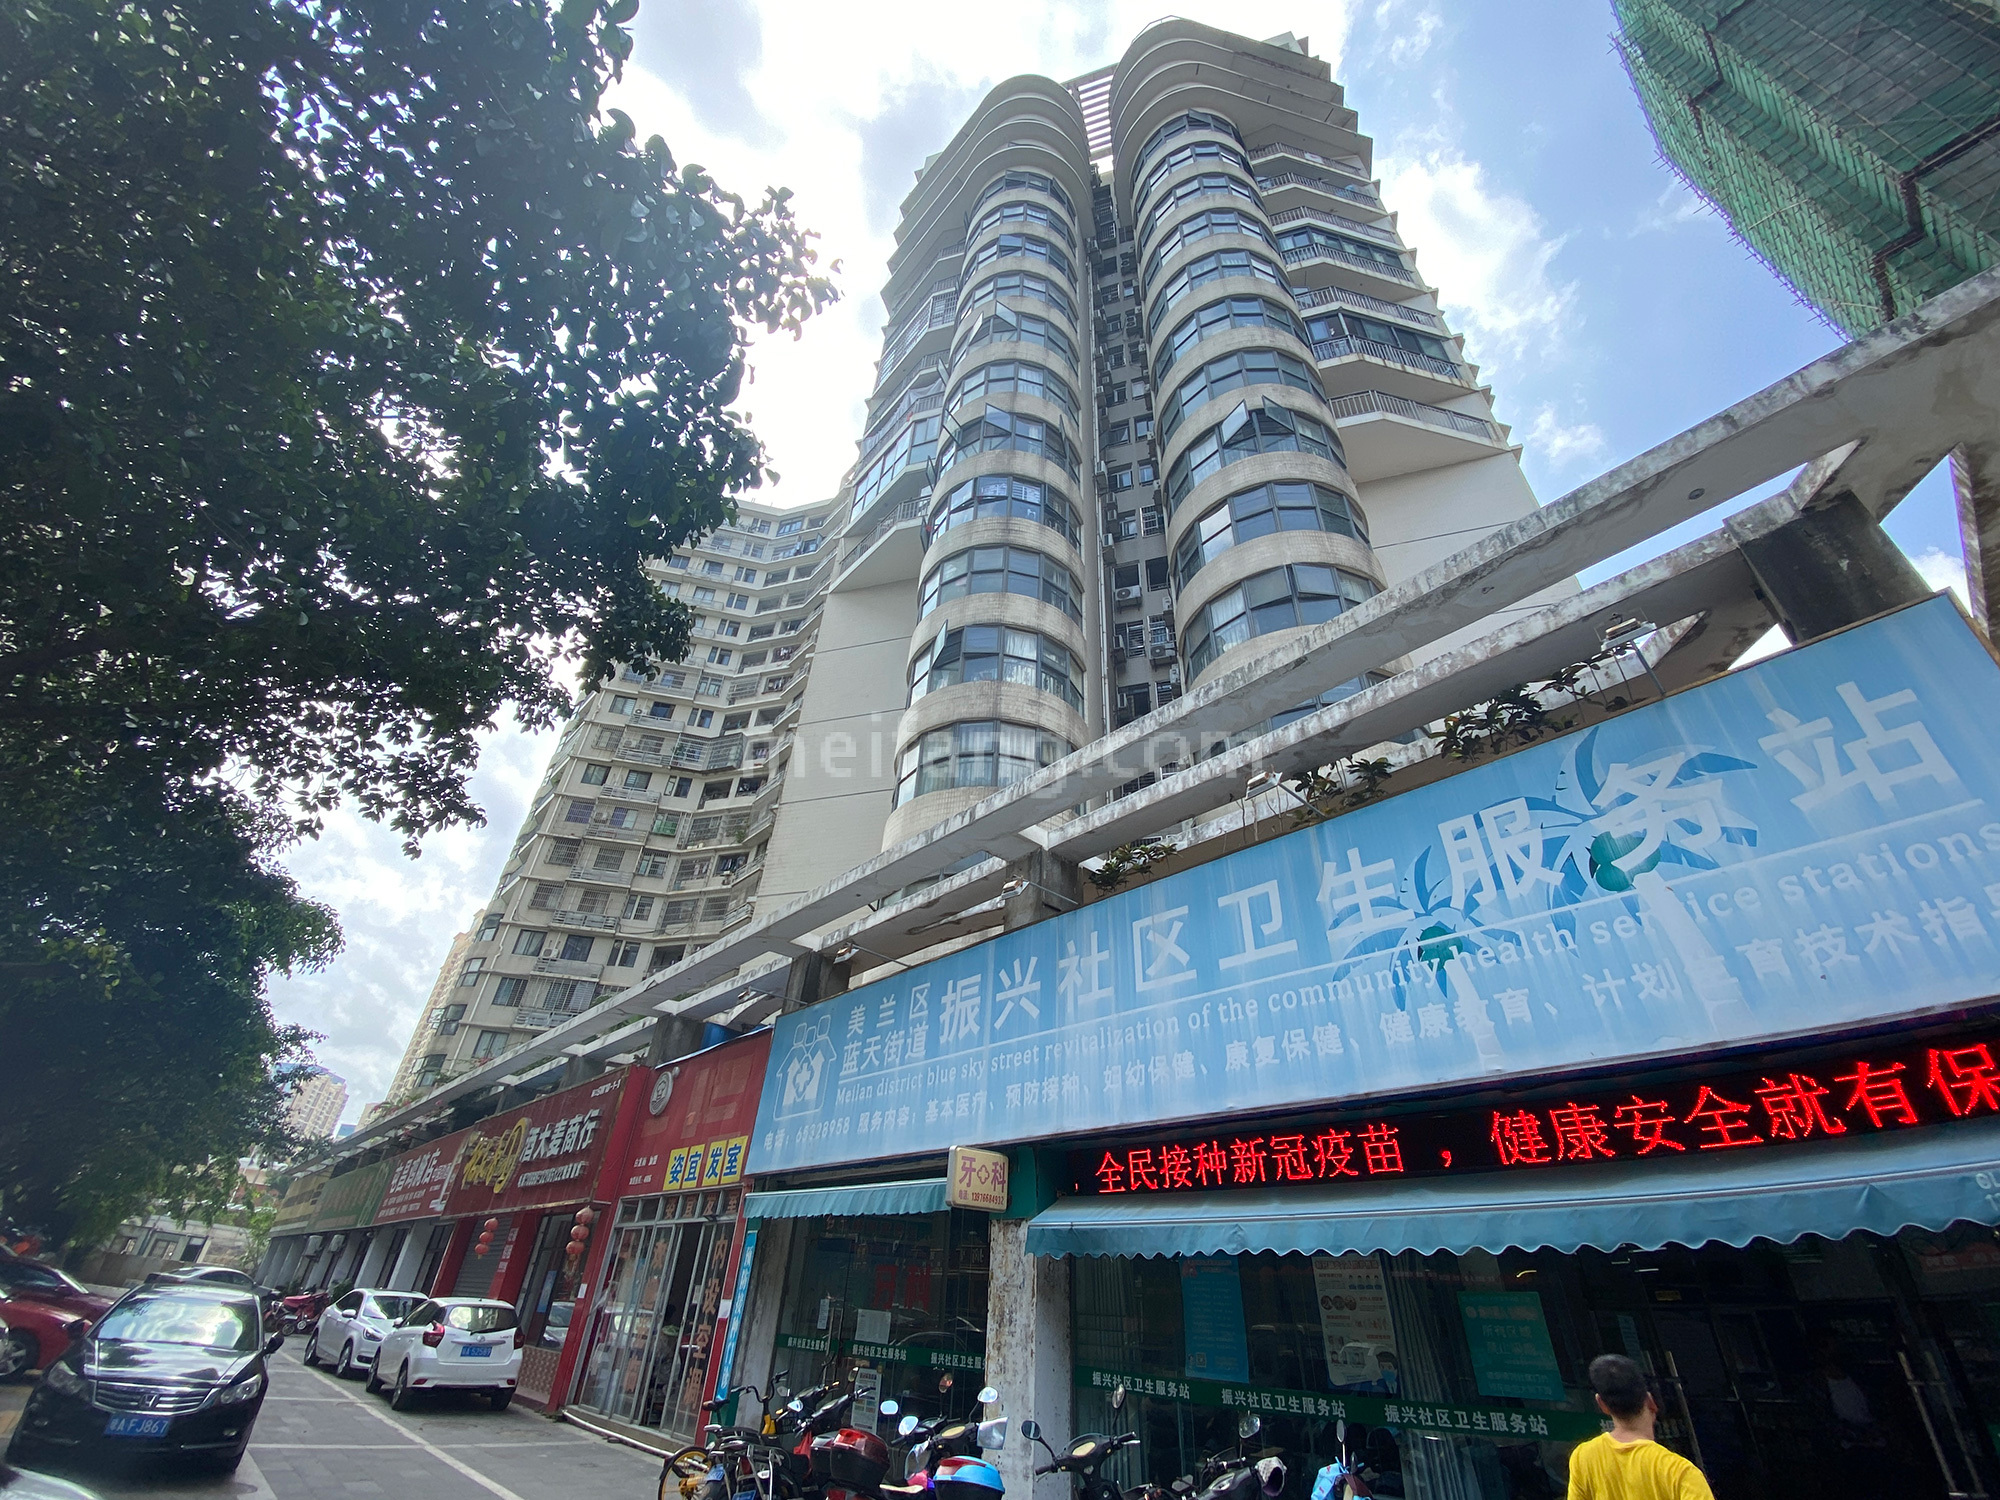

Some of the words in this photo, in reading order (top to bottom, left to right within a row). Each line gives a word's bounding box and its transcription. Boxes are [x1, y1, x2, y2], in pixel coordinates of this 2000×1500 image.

[939, 681, 1966, 1044] 振兴社区卫生服务站
[836, 1084, 873, 1105] Meilan
[877, 1072, 923, 1096] district
[927, 1066, 956, 1086] blue
[961, 1057, 987, 1080] sky
[991, 1045, 1039, 1072] street
[1044, 1015, 1180, 1060] revitalization
[1187, 1001, 1211, 1030] of
[1217, 996, 1259, 1023] the
[1268, 957, 1442, 1013] community
[1449, 923, 1577, 973] health
[1590, 886, 1762, 945] serice
[847, 982, 930, 1038] 美兰区
[840, 1021, 929, 1077] 蓝天街道
[669, 1143, 742, 1185] 姿宜发室
[959, 1156, 1006, 1193] 牙科
[852, 1344, 907, 1361] 振兴社区卫生服务站
[1092, 1371, 1190, 1400] 振兴社区卫生服务站
[1221, 1388, 1346, 1418] 振兴社区卫生服务站
[1384, 1404, 1548, 1436] 振兴社区卫生服务站
